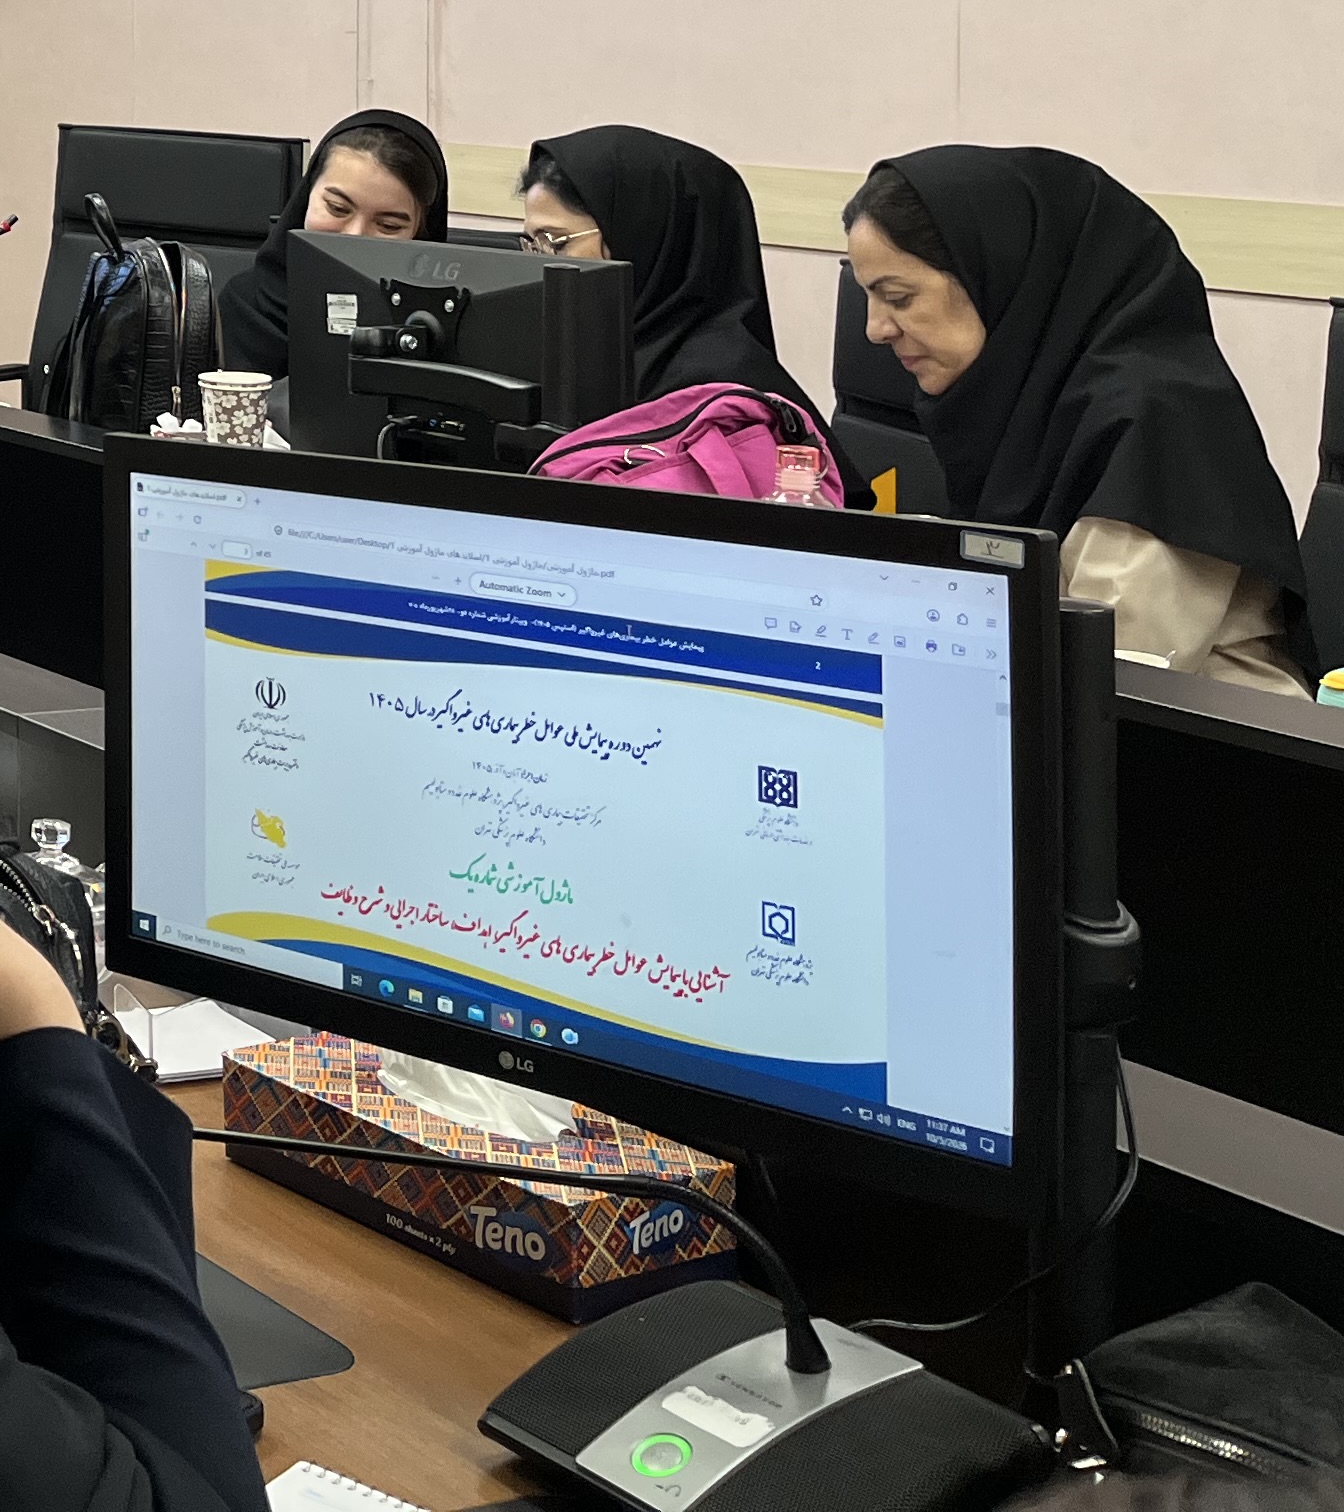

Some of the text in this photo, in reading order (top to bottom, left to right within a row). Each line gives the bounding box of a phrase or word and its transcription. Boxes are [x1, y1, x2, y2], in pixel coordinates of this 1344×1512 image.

[432, 260, 461, 280] LG
[478, 578, 552, 598] Automatic Zoom
[815, 660, 822, 671] 2
[369, 691, 404, 713] ۱۴۰۵
[405, 695, 427, 719] سال
[473, 709, 491, 731] های
[491, 716, 520, 744] بیماری
[519, 711, 536, 738] خطر
[534, 718, 563, 742] عوامل
[564, 725, 579, 748] ملی
[578, 722, 610, 761] پیمایش
[631, 728, 662, 765] نهمین
[449, 853, 574, 905] ماژول آموزشی شماره یک
[320, 883, 359, 916] وظایف
[358, 885, 385, 915] شرح
[390, 895, 419, 929] اجرایی
[420, 903, 450, 927] ساختار
[177, 929, 246, 955] Type here to search
[540, 935, 562, 958] های
[594, 941, 615, 968] خطر
[564, 945, 596, 976] بیماری
[613, 951, 647, 976] عوامل
[648, 953, 686, 997] پیمایش
[690, 965, 731, 1002] آشنایی
[516, 1056, 534, 1073] LG
[897, 1118, 917, 1132] ENG
[949, 1125, 967, 1137] AM
[385, 1213, 403, 1229] 100
[404, 1224, 428, 1242] sheets
[434, 1235, 442, 1248] 2
[442, 1242, 457, 1256] ply
[469, 1205, 546, 1261] Teno
[629, 1209, 684, 1255] Teno
